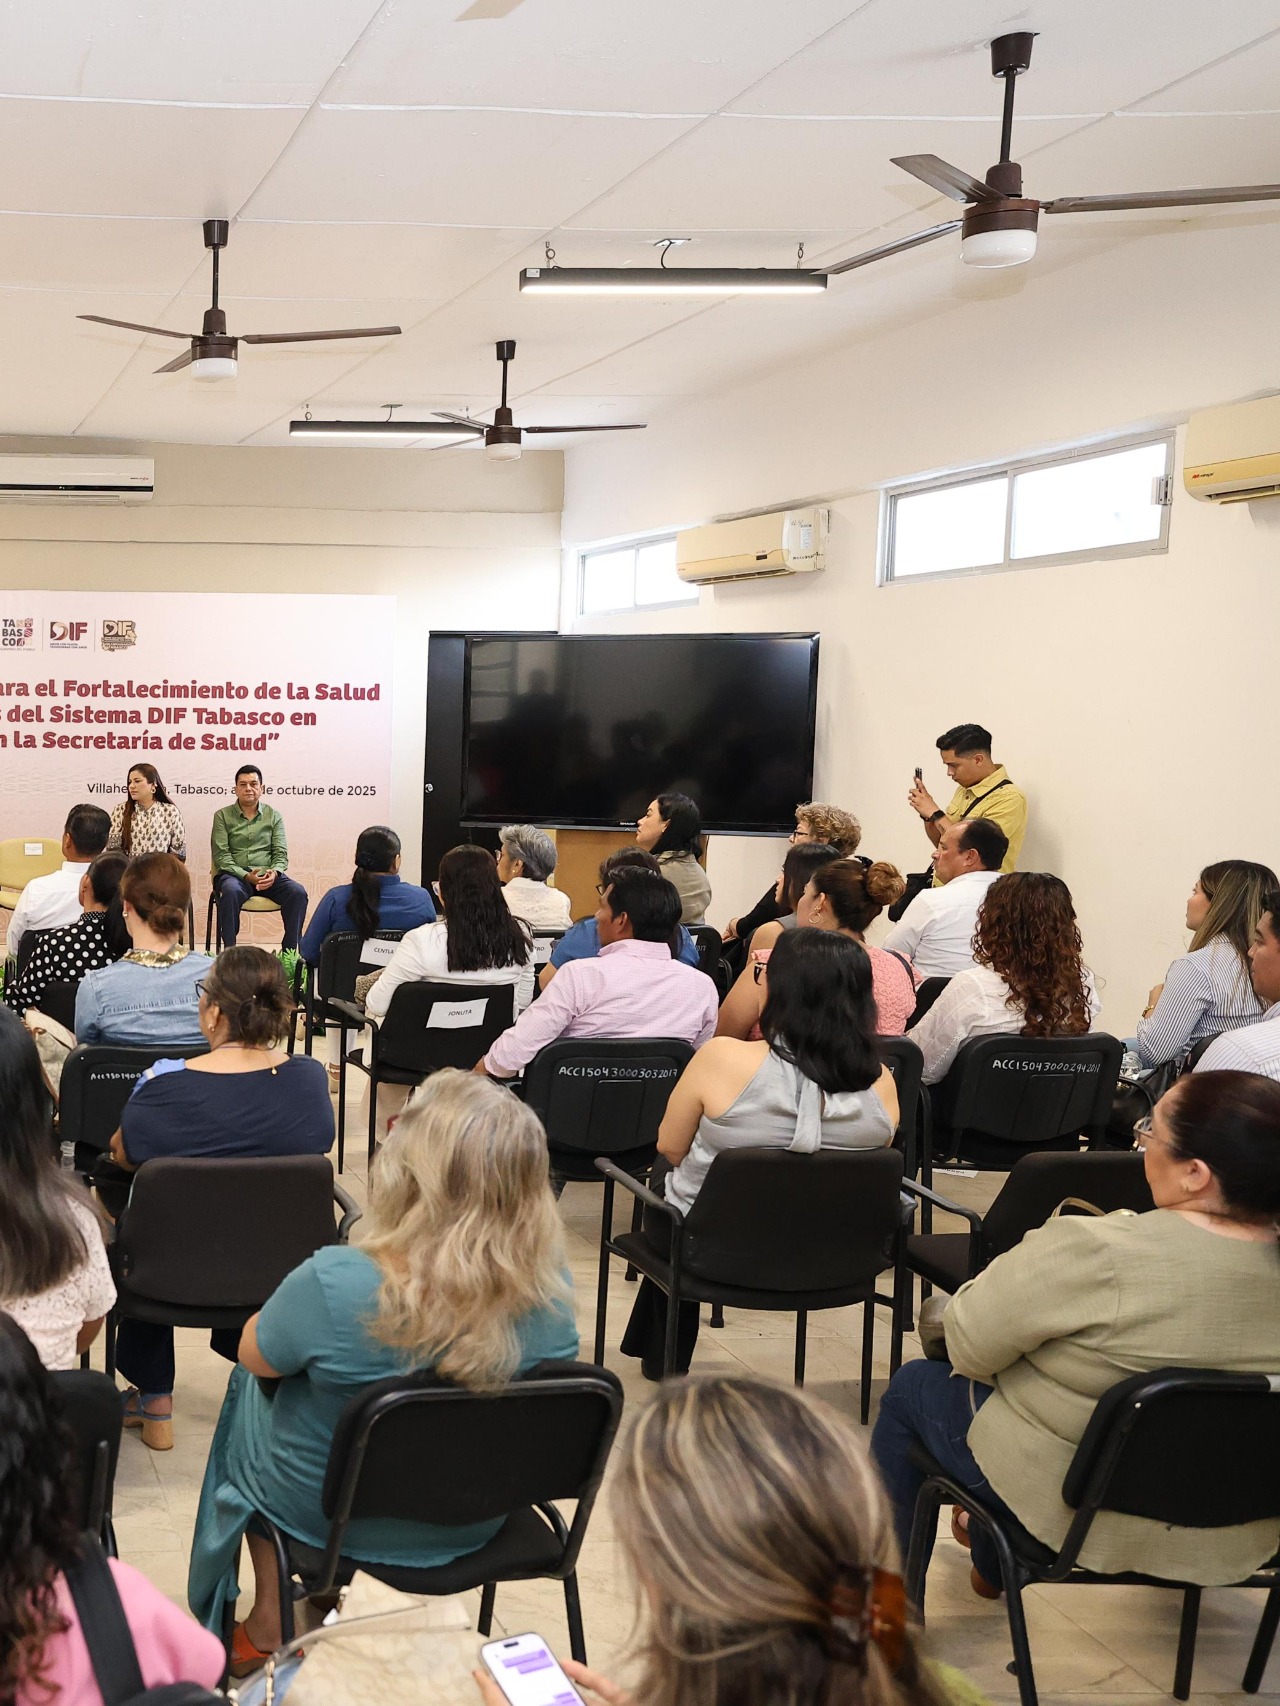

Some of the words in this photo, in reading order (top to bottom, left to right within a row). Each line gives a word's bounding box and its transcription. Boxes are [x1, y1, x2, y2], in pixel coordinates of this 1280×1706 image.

[49, 621, 88, 641] DIF
[103, 620, 133, 636] DIF
[34, 679, 58, 697] el
[63, 679, 249, 700] Fortalecimiento
[254, 682, 282, 700] de
[287, 682, 310, 701] la
[315, 683, 380, 701] Salud
[6, 704, 44, 723] del
[49, 703, 142, 724] Sistema
[147, 706, 187, 724] DIF
[193, 707, 285, 726] Tabasco
[289, 712, 317, 726] en
[13, 730, 38, 749] la
[42, 729, 163, 750] Secretaría
[168, 732, 196, 751] de
[174, 783, 228, 797] Tabasco;
[277, 784, 325, 797] octubre
[328, 784, 344, 797] de
[347, 785, 377, 797] 2025
[447, 1008, 473, 1018] JONUTA
